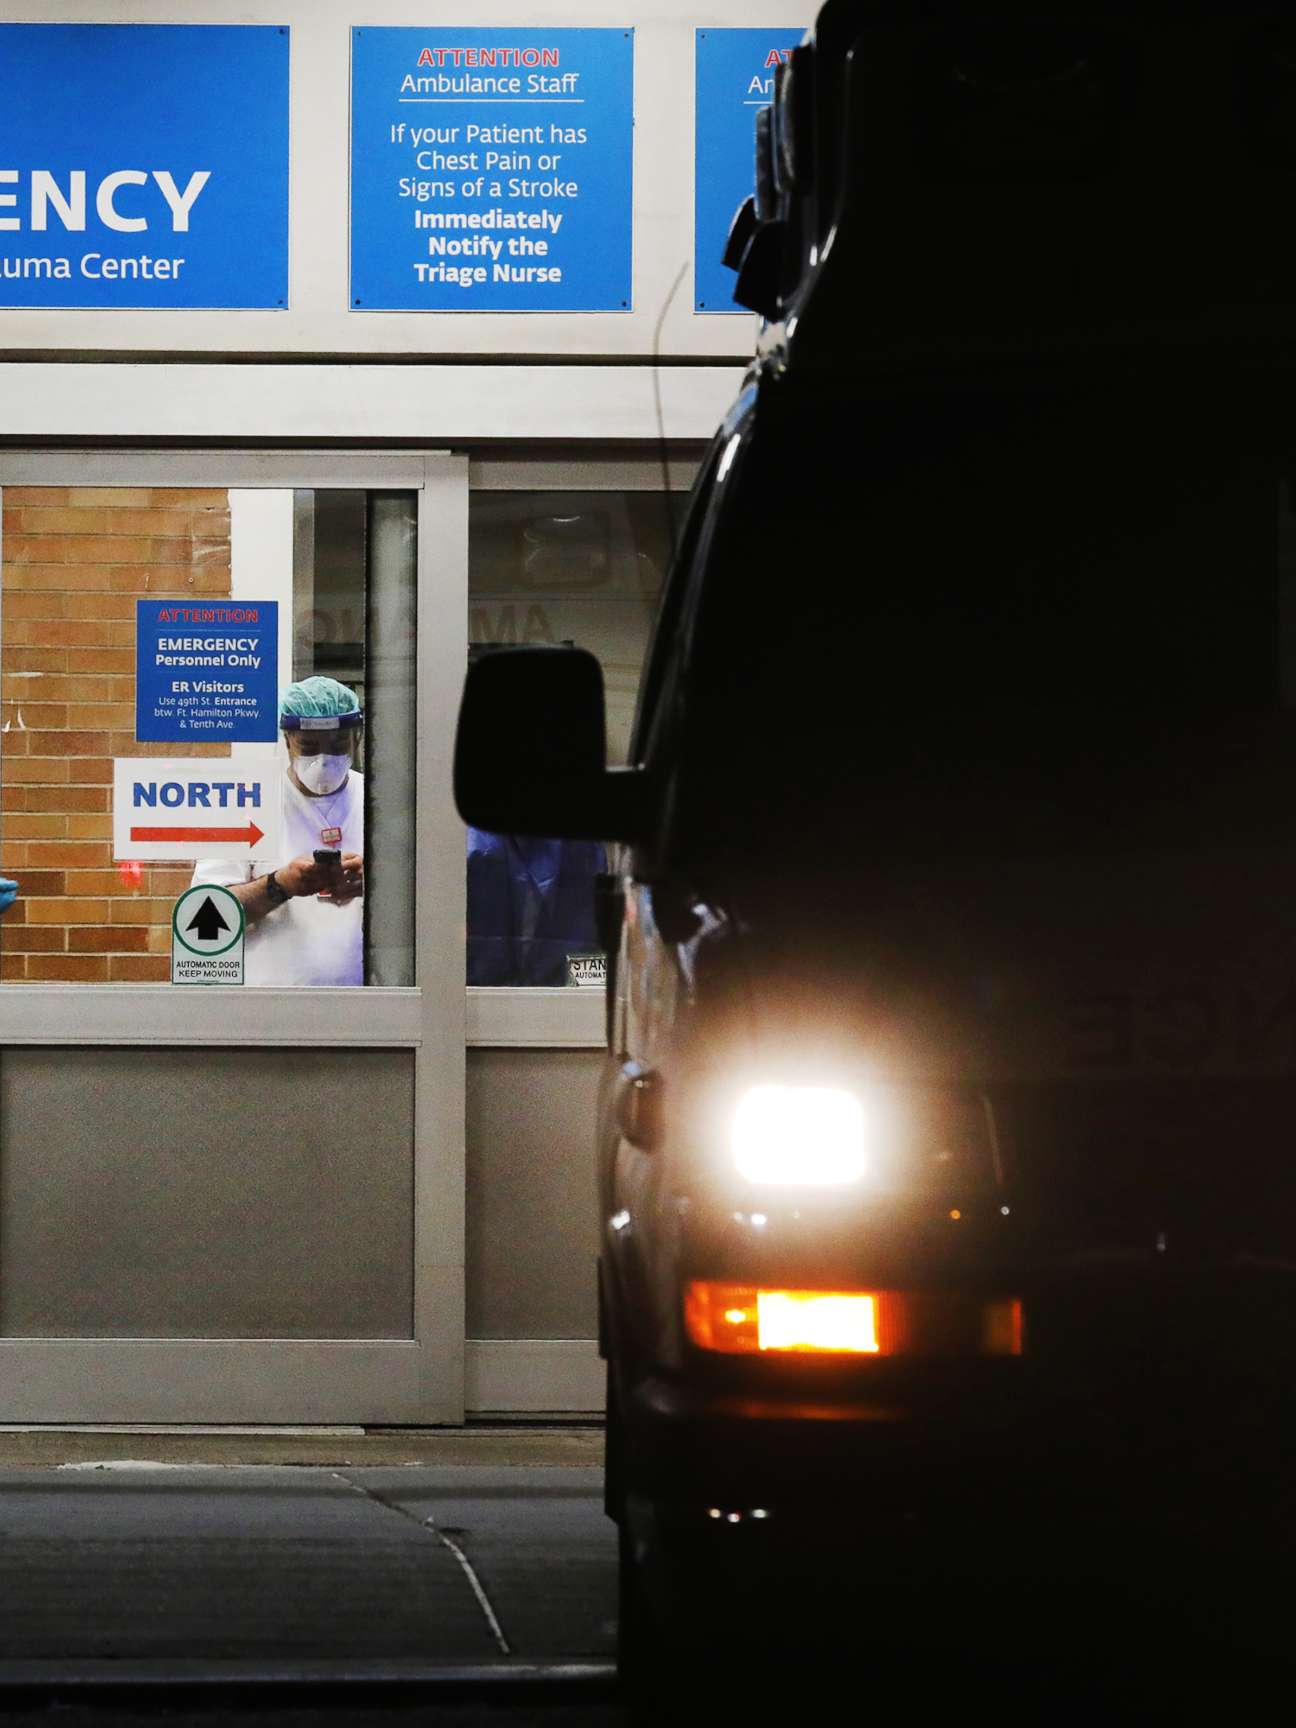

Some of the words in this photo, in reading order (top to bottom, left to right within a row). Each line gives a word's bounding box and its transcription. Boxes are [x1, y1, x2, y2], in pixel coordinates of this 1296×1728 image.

[416, 47, 560, 68] ATTENTION
[400, 72, 521, 94] Ambulance
[527, 72, 580, 94] Staff
[391, 123, 406, 143] If
[410, 127, 460, 148] your
[466, 123, 545, 144] Patient
[550, 123, 587, 144] has
[416, 150, 479, 171] Chest
[485, 150, 531, 171] Pain
[537, 154, 561, 171] or
[399, 176, 456, 202] Signs
[461, 176, 485, 198] of
[488, 181, 502, 198] a
[508, 176, 578, 198] Stroke
[414, 207, 563, 234] Immediately
[428, 234, 503, 261] Notify
[507, 235, 549, 256] the
[80, 253, 185, 280] Center
[413, 261, 488, 288] Triage
[492, 263, 562, 283] Nurse
[158, 607, 259, 624] ATTENTION
[158, 638, 259, 651] EMERGENCY
[155, 653, 225, 666] Personnel
[227, 654, 261, 669] Only
[171, 681, 190, 693] ER
[192, 680, 245, 693] Visitors
[158, 697, 176, 706] Use
[177, 696, 199, 707] 49th
[214, 696, 258, 706] Entrance
[190, 707, 233, 718] Hamilton
[179, 719, 187, 729] &
[188, 719, 215, 729] Tenth
[132, 782, 261, 808] NORTH
[176, 960, 218, 969] AUTOMATIC
[218, 961, 241, 969] DOOR
[178, 969, 202, 978] KEEP
[203, 969, 238, 978] MOVING
